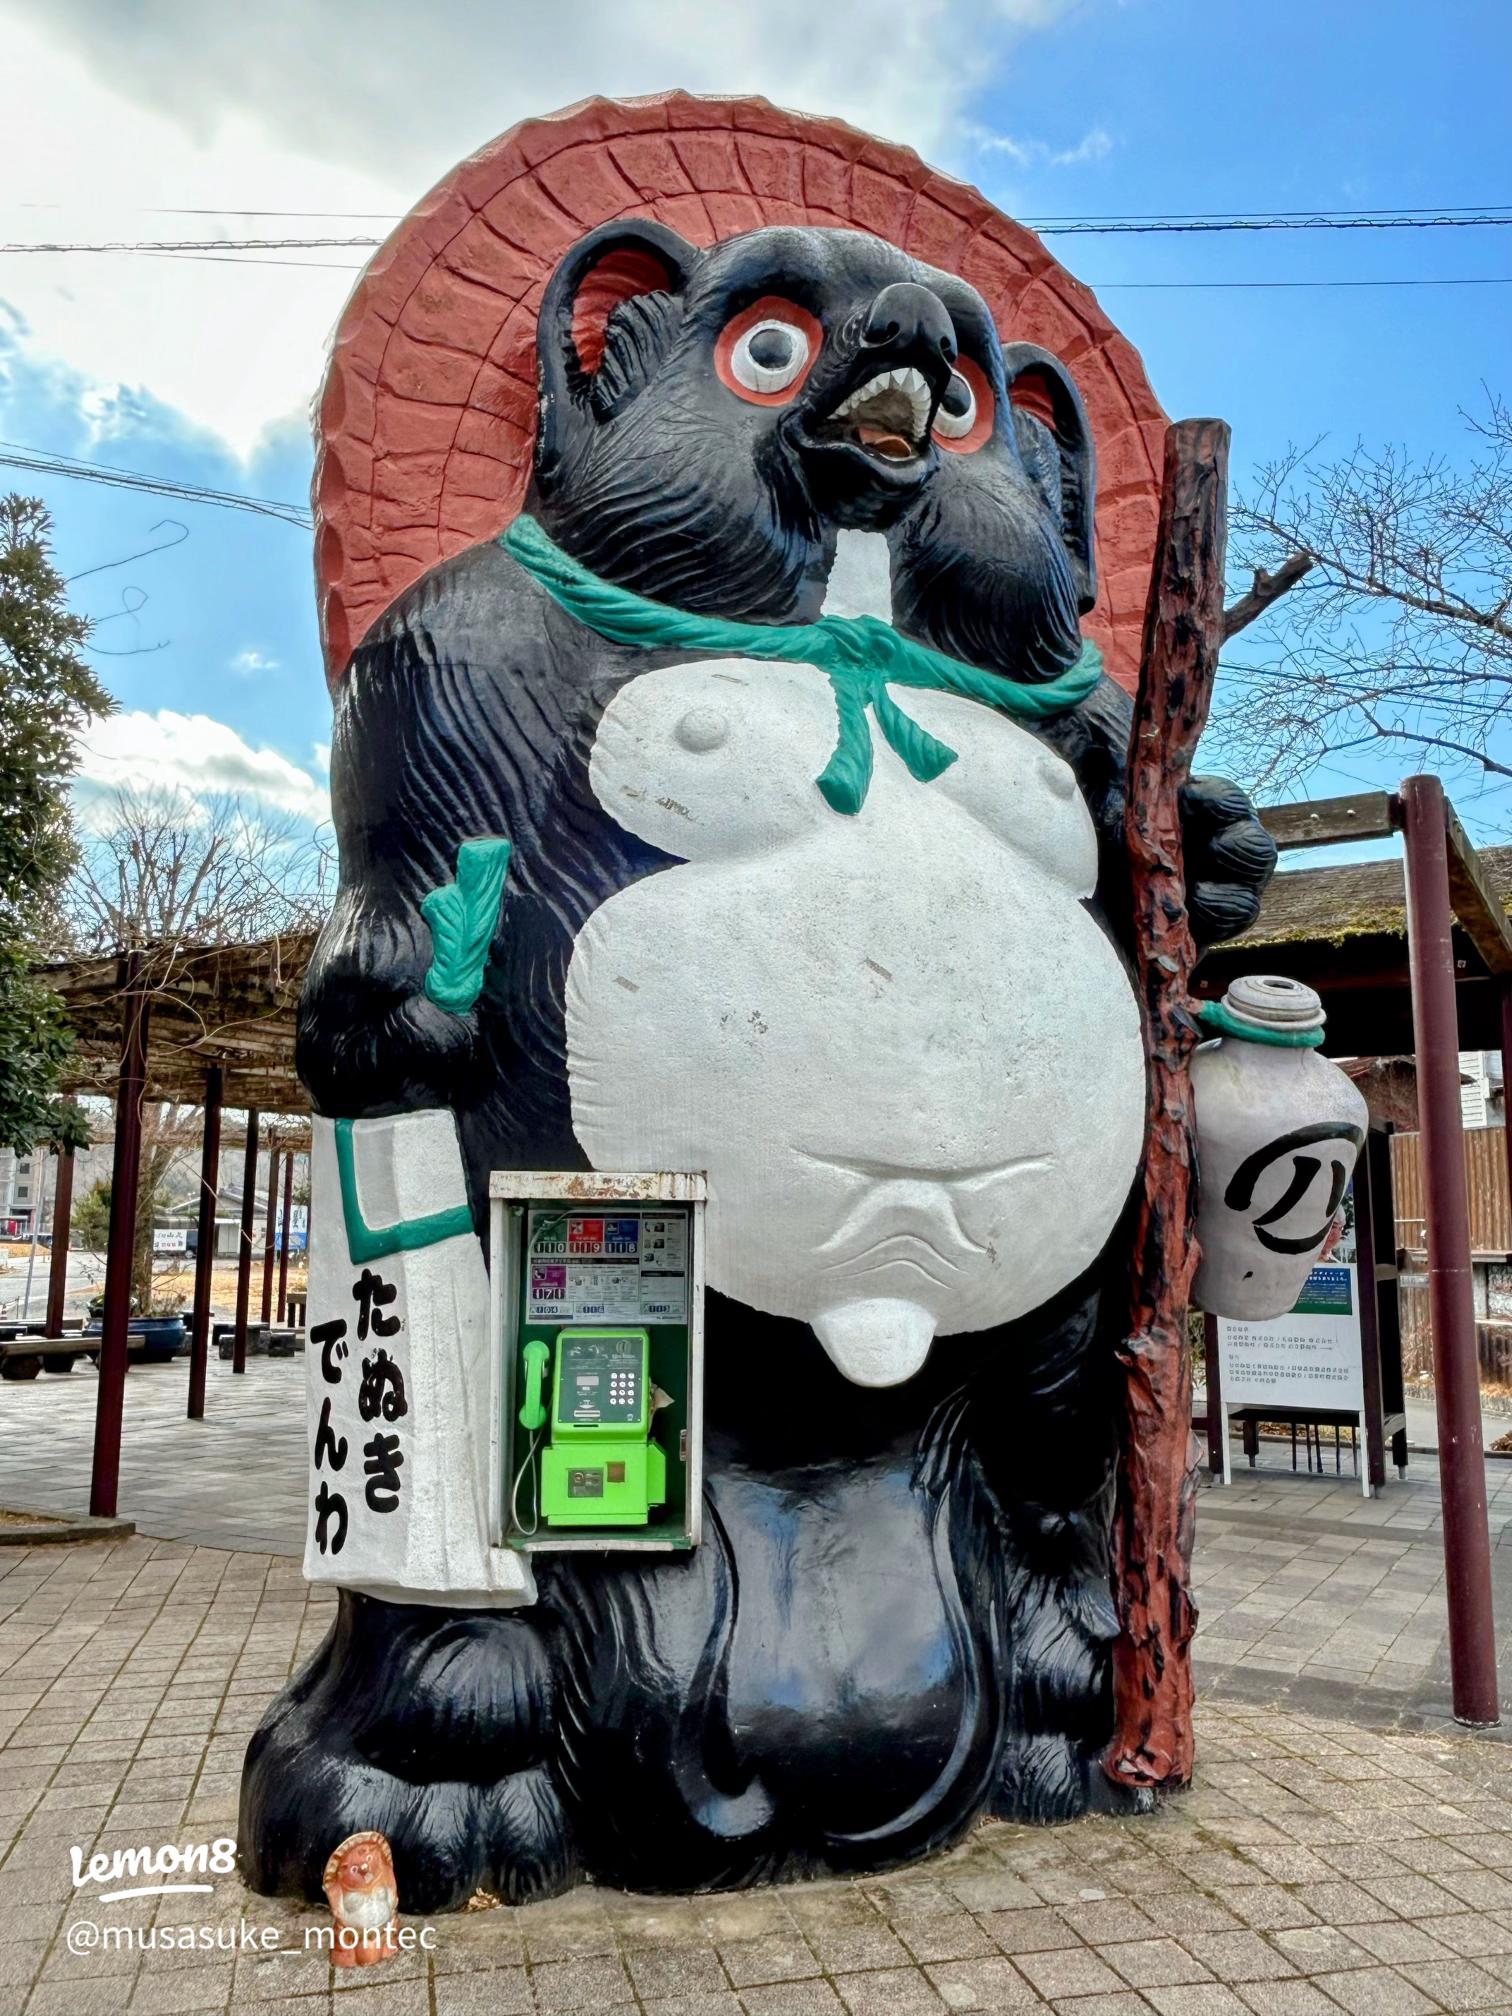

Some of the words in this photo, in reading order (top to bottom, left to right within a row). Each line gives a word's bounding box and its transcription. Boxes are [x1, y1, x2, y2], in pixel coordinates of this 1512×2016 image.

[536, 1243, 565, 1253] 110
[573, 1243, 600, 1253] 119
[608, 1243, 636, 1253] 118
[534, 1289, 563, 1299] 171
[352, 1268, 407, 1514] たぬき
[310, 1319, 349, 1555] でんわ
